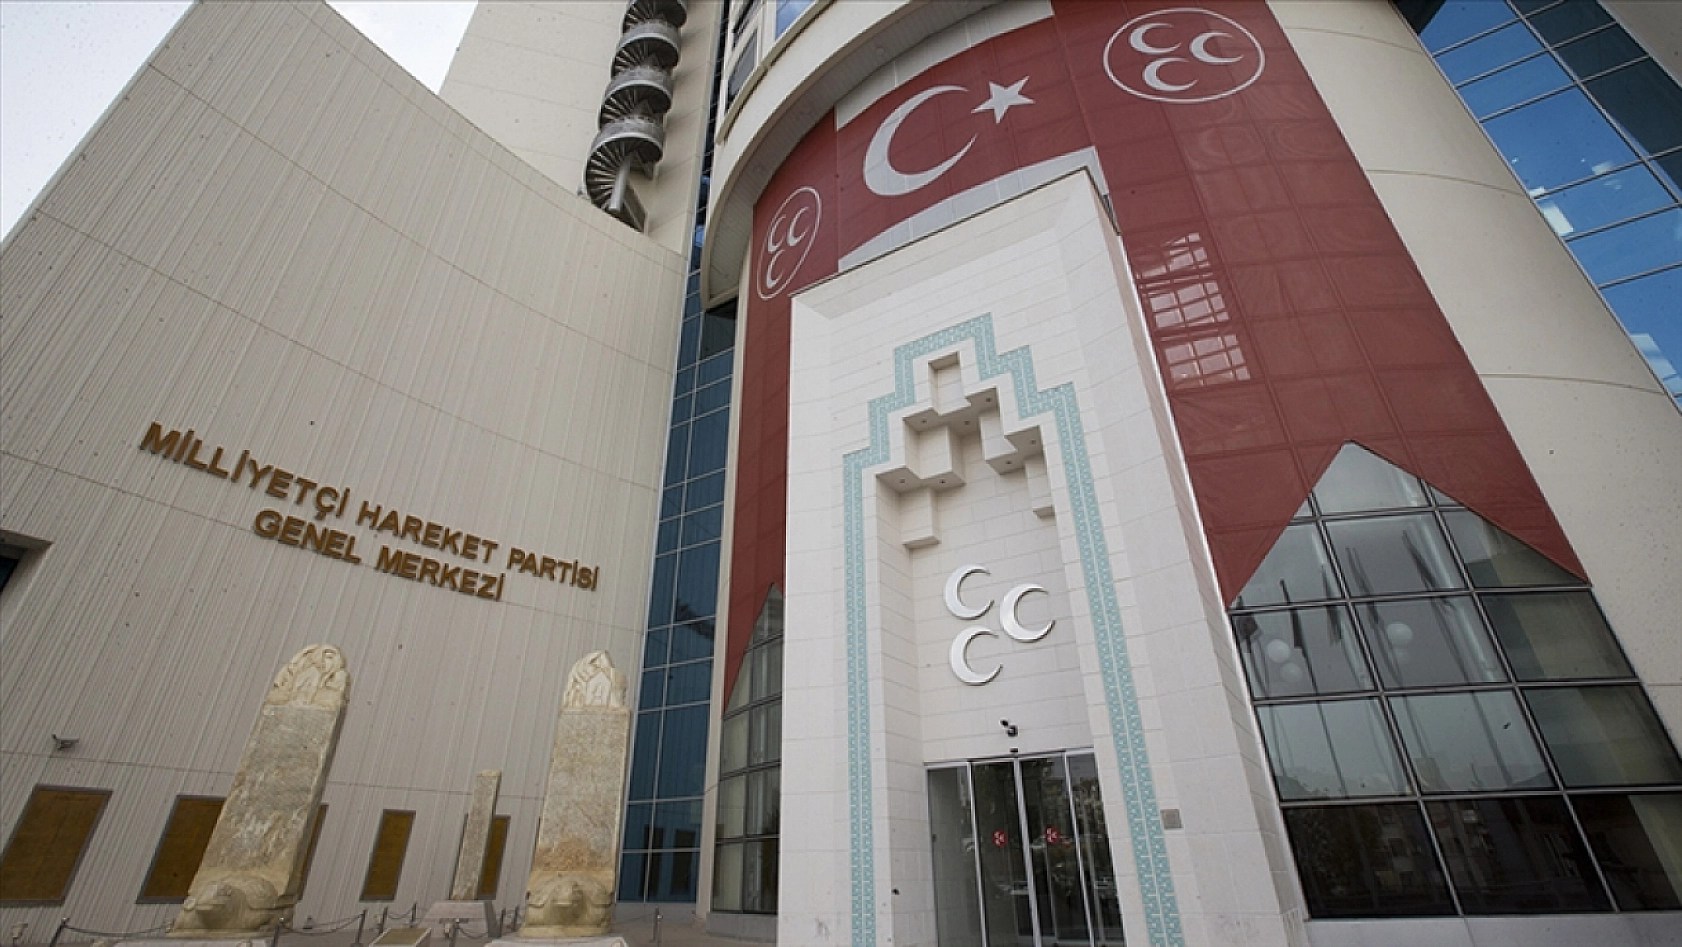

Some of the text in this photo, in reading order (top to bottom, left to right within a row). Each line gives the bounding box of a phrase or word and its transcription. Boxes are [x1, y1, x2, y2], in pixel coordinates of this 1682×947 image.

[139, 421, 599, 592] MİLLİYETÇİ HAREKET PARTİSİ
[253, 509, 506, 602] GENEL MERKEZİ
